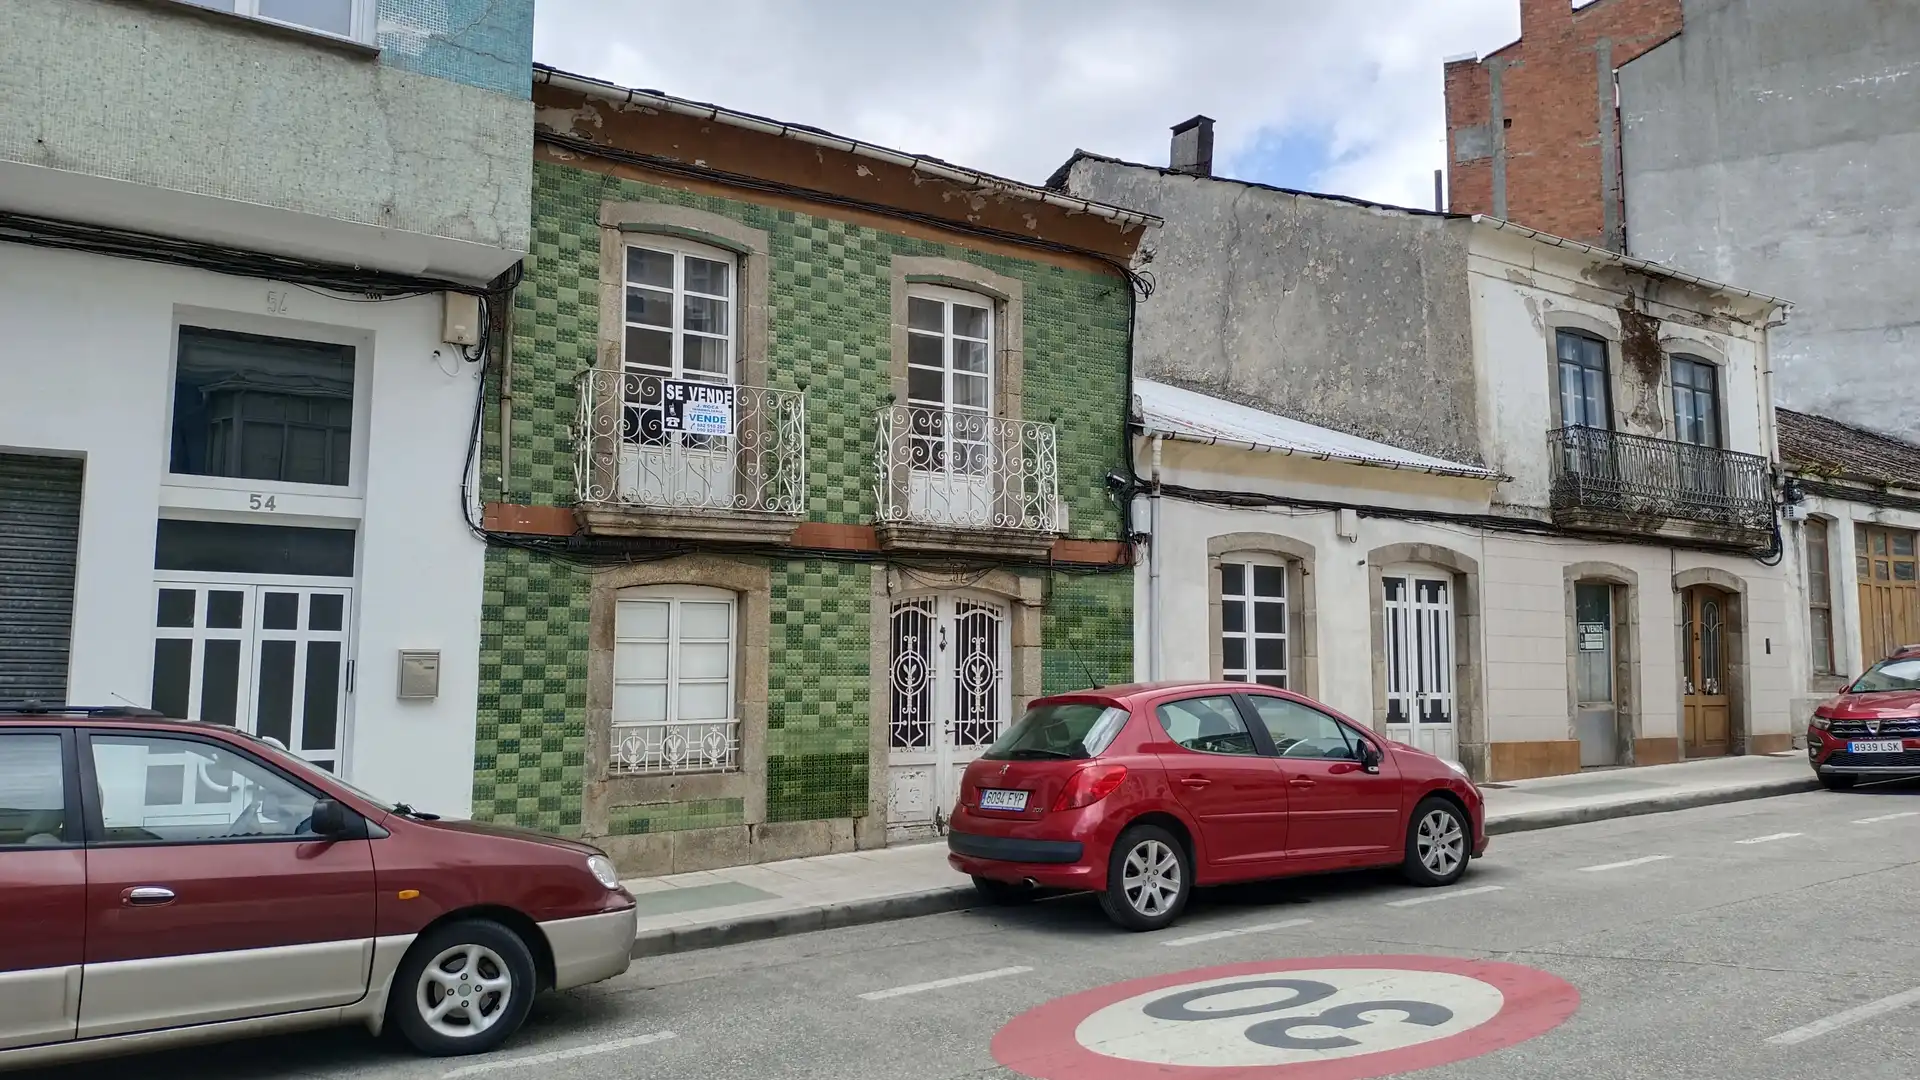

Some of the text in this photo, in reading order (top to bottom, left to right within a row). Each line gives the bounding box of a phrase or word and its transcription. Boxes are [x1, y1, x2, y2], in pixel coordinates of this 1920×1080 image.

[666, 384, 732, 405] SE VENDE
[689, 413, 727, 424] VENDE
[249, 493, 276, 511] 54
[1586, 624, 1603, 633] VENDE
[1854, 742, 1900, 752] 8939 LSK
[986, 791, 1025, 806] 6094 FYP
[1141, 978, 1454, 1050] 30
